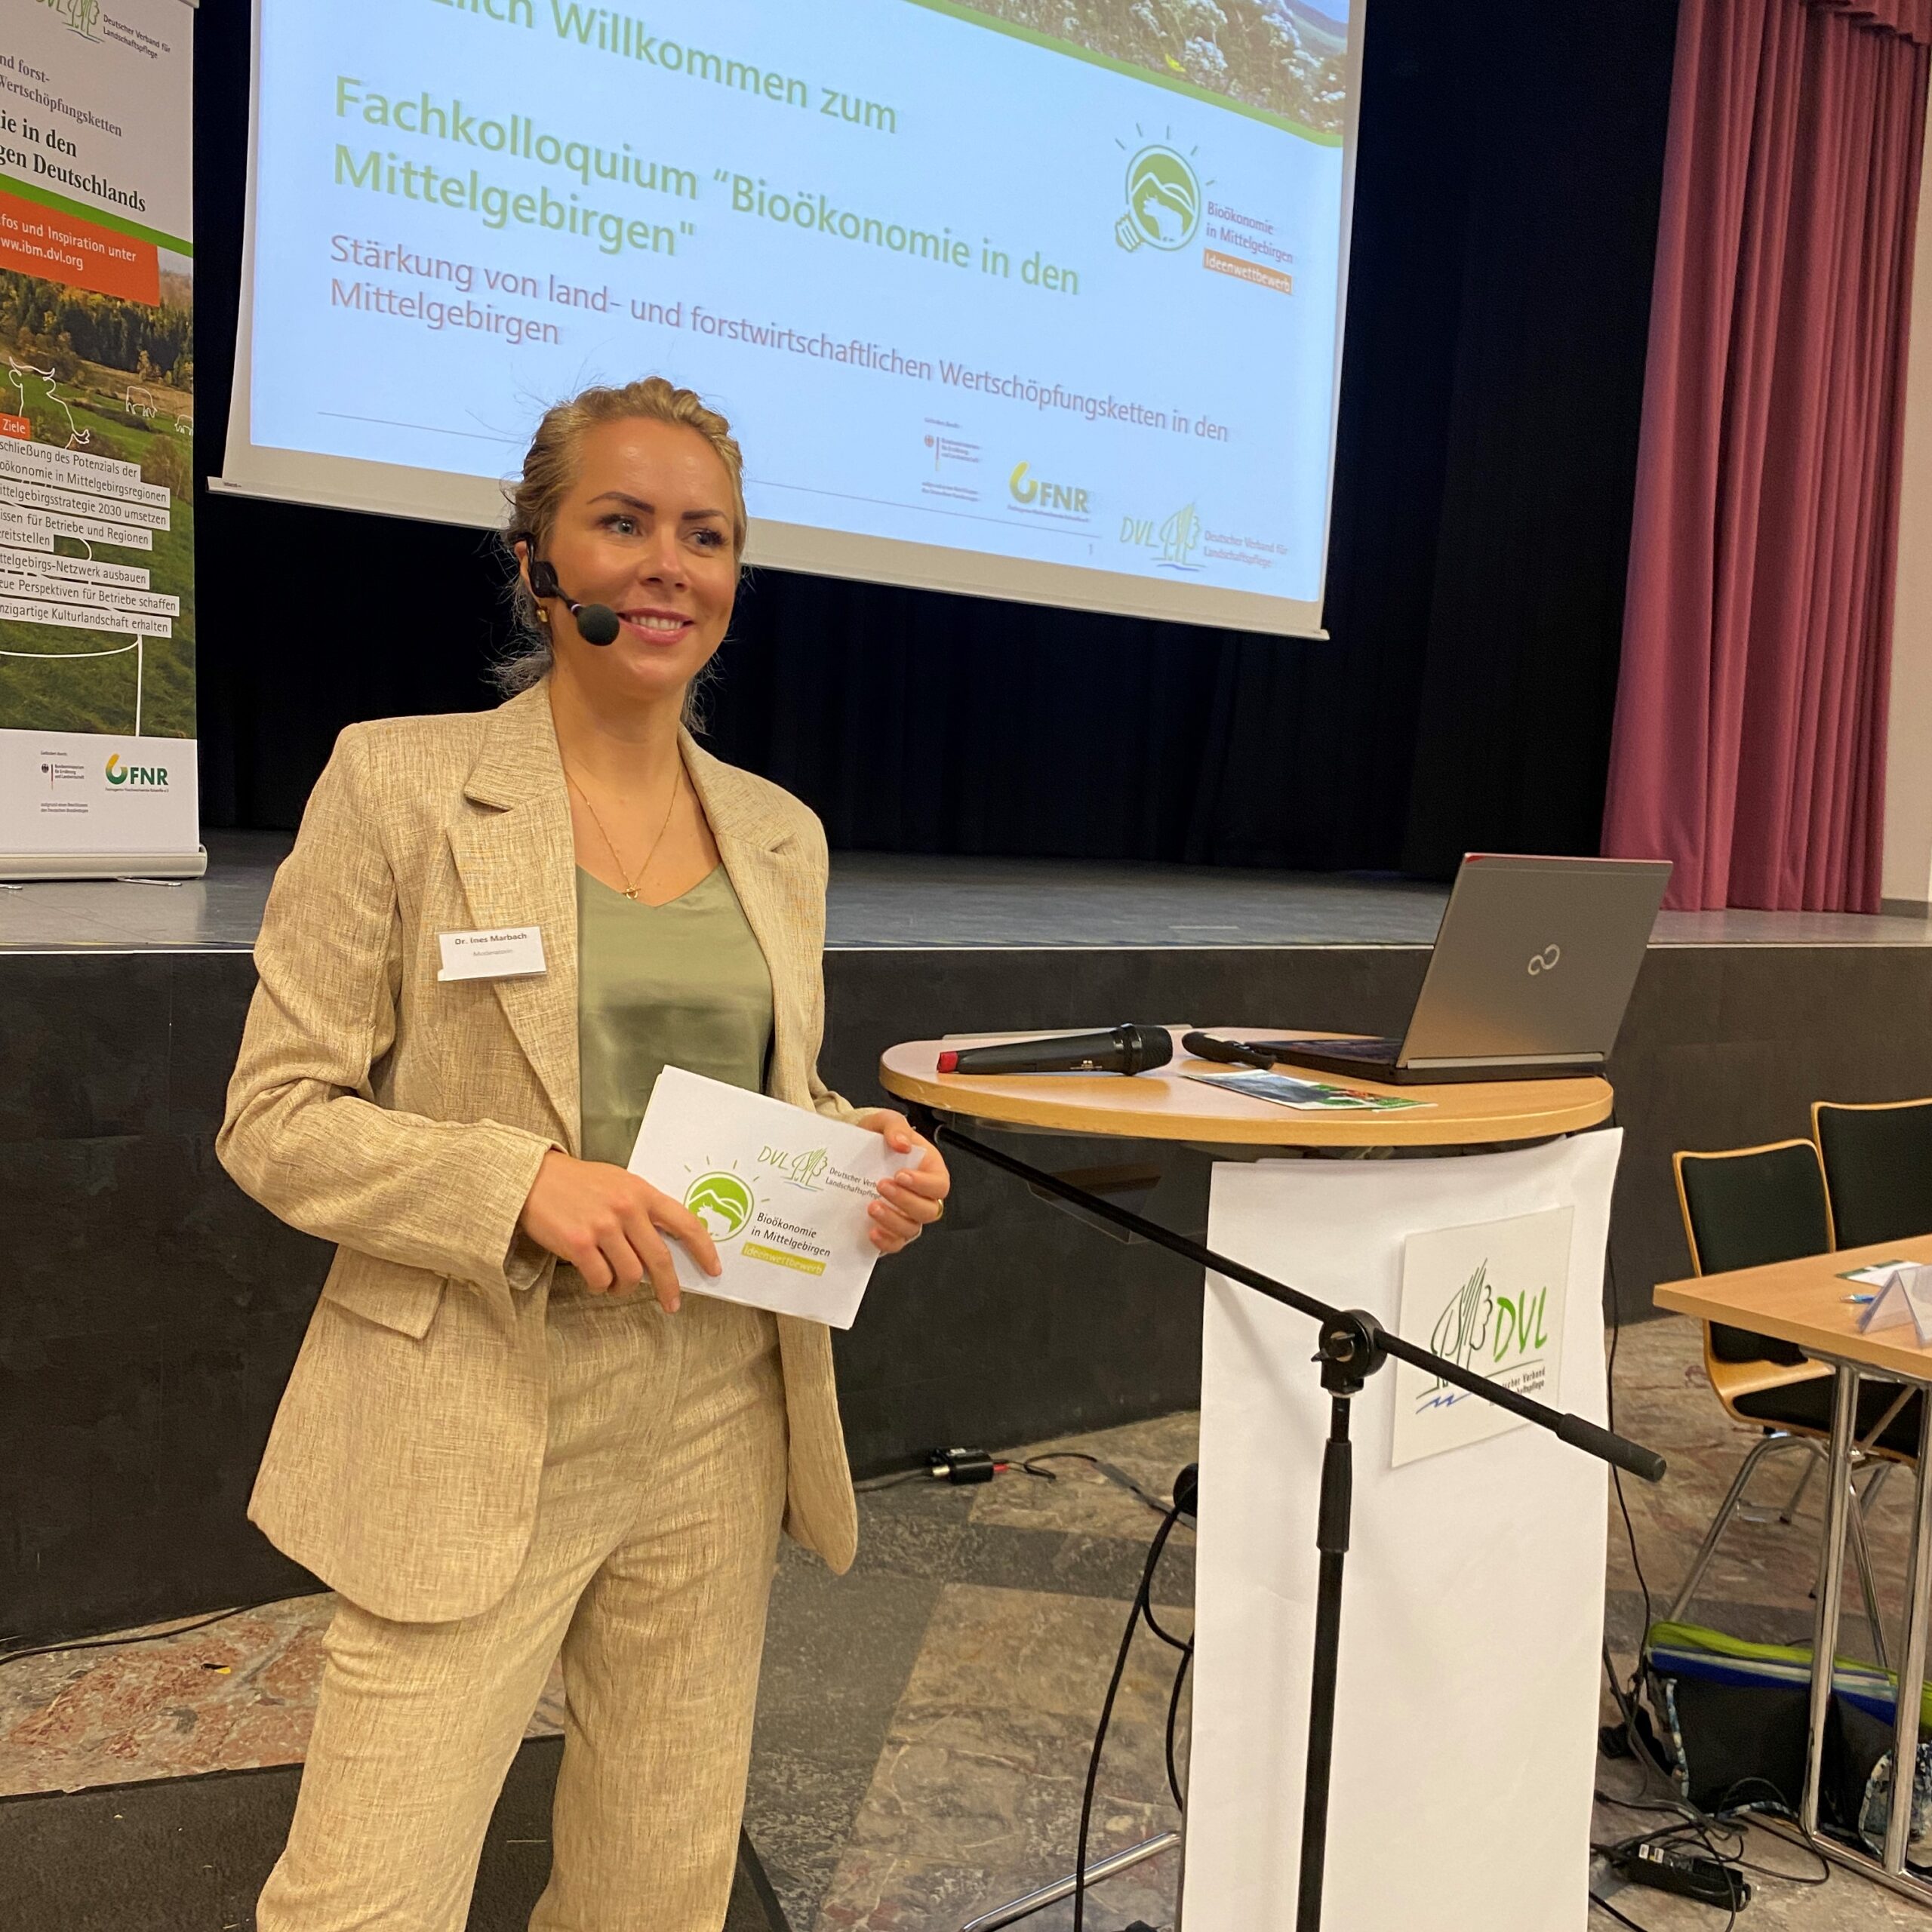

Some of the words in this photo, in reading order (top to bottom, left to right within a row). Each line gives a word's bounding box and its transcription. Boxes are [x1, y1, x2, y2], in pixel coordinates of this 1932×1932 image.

[103, 14, 134, 35] Deutscher
[135, 30, 160, 48] Verband
[162, 42, 171, 53] für
[103, 26, 158, 59] Landschaftspflege
[18, 60, 50, 83] forst-
[550, 0, 808, 108] Willkommen
[820, 88, 897, 134] zum
[23, 118, 40, 143] in
[46, 129, 77, 158] den
[32, 153, 146, 212] Deutschlands
[336, 75, 697, 199] Fachkolloquium
[982, 238, 1010, 278] in
[1021, 252, 1079, 295] den
[1208, 202, 1274, 235] Bioökonomie
[0, 214, 18, 229] fos
[23, 222, 43, 236] und
[48, 227, 105, 253] Inspiration
[108, 248, 137, 262] unter
[1207, 223, 1217, 237] in
[1220, 227, 1294, 263] Mittelgebirgen
[1206, 253, 1291, 293] Ideenwettbewerb
[331, 278, 560, 344] Mittelgebirgen
[331, 235, 474, 292] Stärkung
[484, 268, 537, 298] von
[548, 275, 621, 312] land-
[630, 299, 681, 328] und
[691, 306, 932, 381] forstwirtschaftlichen
[940, 359, 1166, 429] Wertschöpfungsketten
[1172, 410, 1189, 435] in
[1195, 415, 1229, 442] den
[2, 419, 26, 434] Ziele
[55, 452, 69, 464] des
[73, 457, 119, 475] Potenzials
[122, 466, 137, 478] der
[56, 469, 63, 481] in
[67, 472, 167, 502] Mittelgebirgsregionen
[1041, 481, 1089, 513] FNR
[27, 513, 42, 526] für
[45, 517, 84, 534] Betriebe
[88, 525, 104, 537] und
[108, 528, 149, 544] Regionen
[99, 503, 122, 516] 2030
[125, 510, 166, 525] umsetzen
[1120, 517, 1159, 547] DVL
[103, 569, 146, 584] ausbauen
[19, 580, 78, 598] Perspektiven
[83, 588, 96, 601] für
[99, 591, 136, 606] Betriebe
[139, 596, 176, 611] schaffen
[52, 608, 129, 629] Kulturlandschaft
[132, 619, 168, 633] erhalten
[131, 767, 168, 786] FNR
[491, 933, 527, 942] Marbach
[758, 1146, 789, 1171] DVL
[829, 1167, 861, 1183] Deutscher
[863, 1177, 877, 1188] Verb
[757, 1212, 817, 1238] Bioökonomie
[751, 1226, 761, 1237] in
[764, 1229, 831, 1257] Mittelgebirgen
[743, 1244, 823, 1274] Ideenwettbewerb
[1494, 1286, 1547, 1362] DVL
